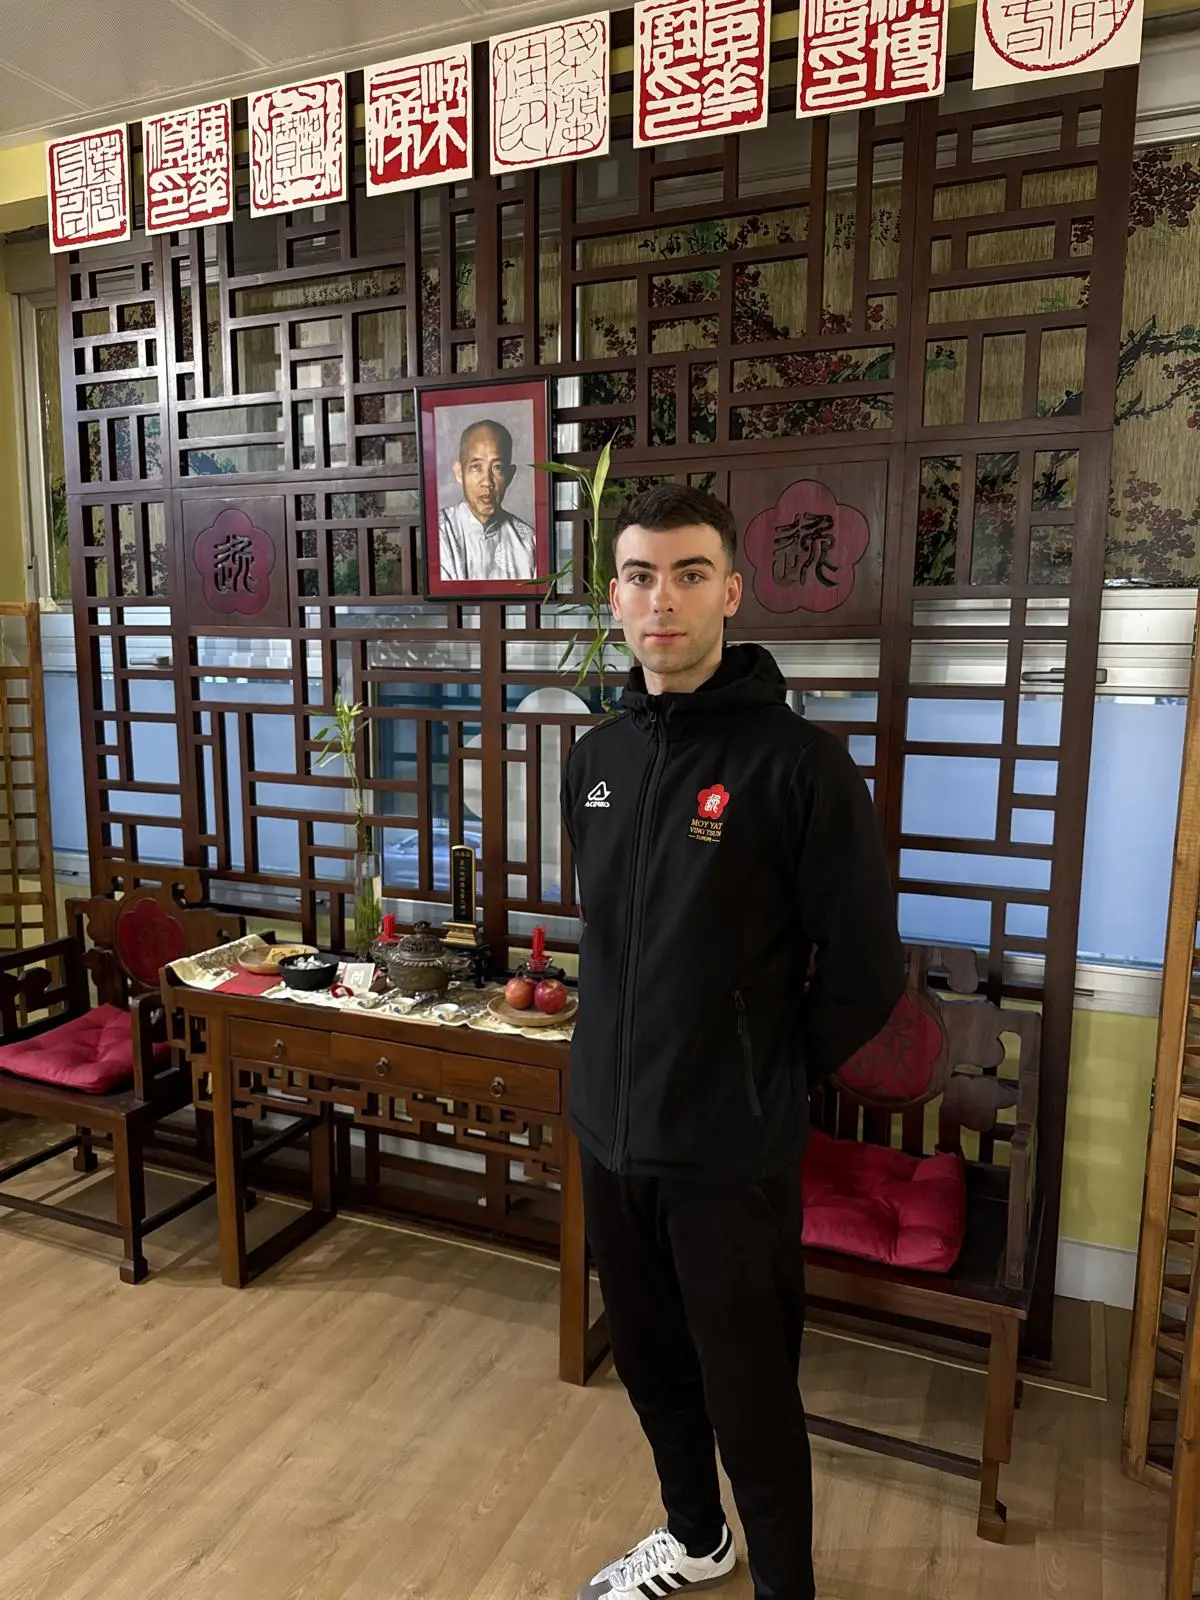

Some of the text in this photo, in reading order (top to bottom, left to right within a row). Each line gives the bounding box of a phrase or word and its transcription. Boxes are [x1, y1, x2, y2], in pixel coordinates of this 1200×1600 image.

[690, 818, 724, 830] MOY YAT
[690, 826, 722, 837] VING TSUN
